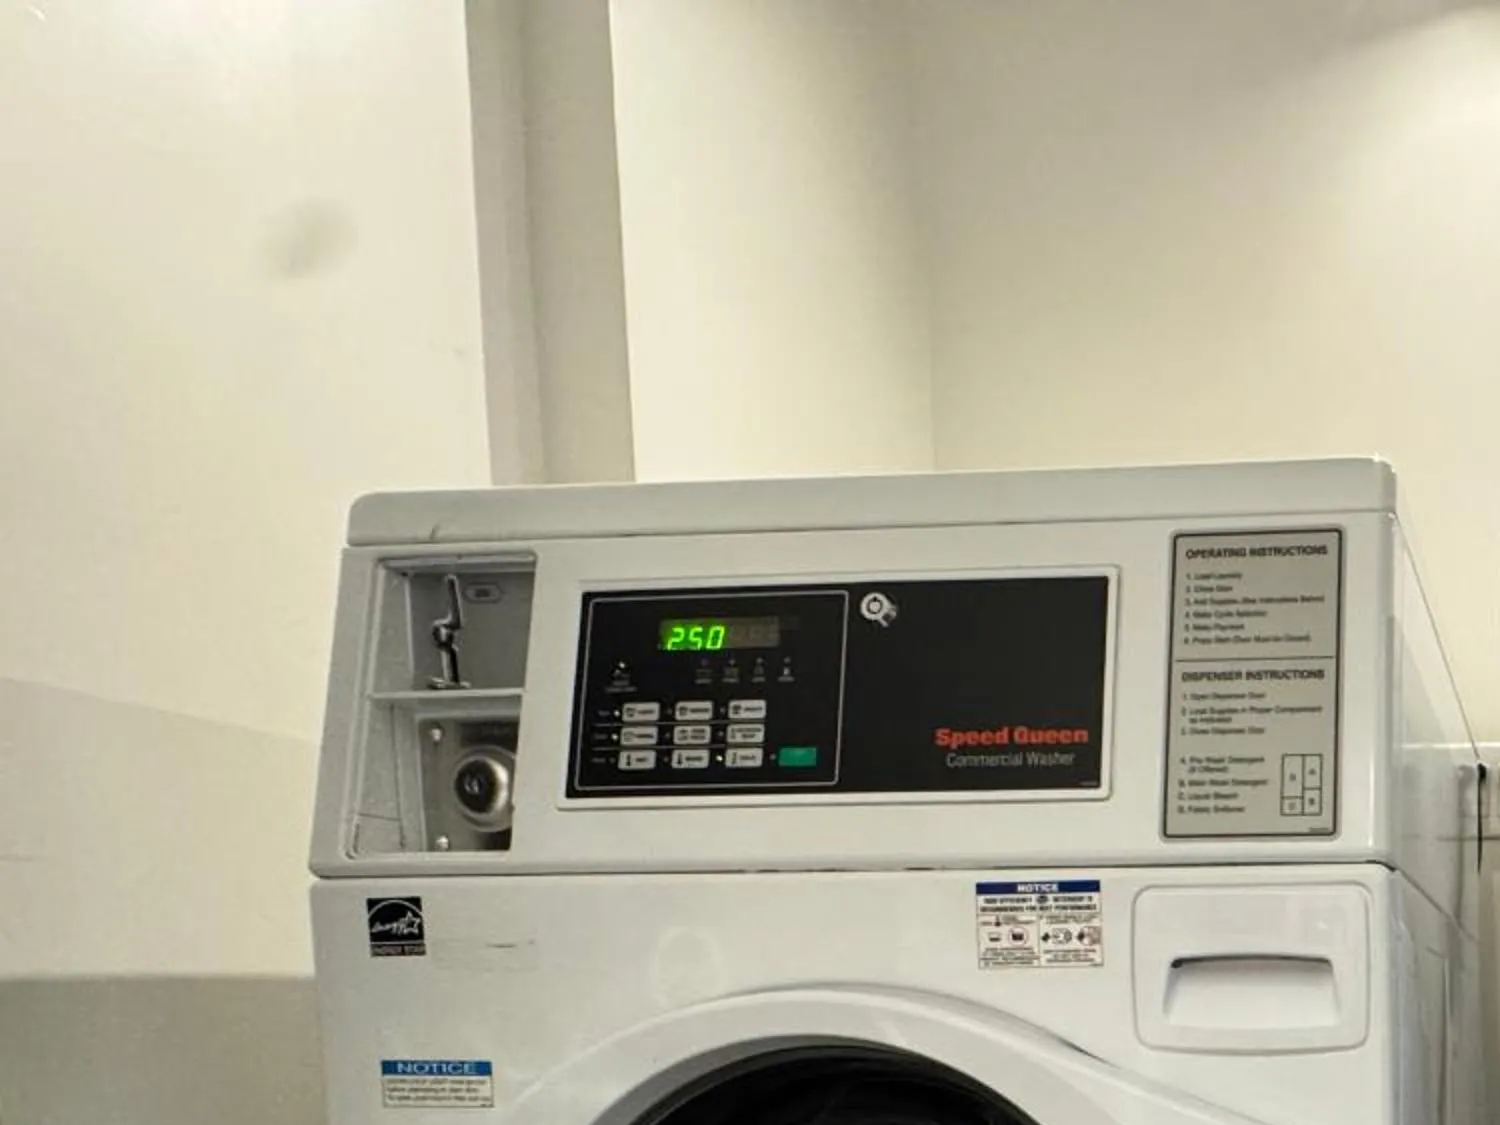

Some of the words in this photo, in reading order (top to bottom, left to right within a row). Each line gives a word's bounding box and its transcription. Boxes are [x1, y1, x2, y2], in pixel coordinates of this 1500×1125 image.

[1185, 547, 1247, 560] OPERATING
[1249, 544, 1328, 557] INSTRUCTIONS
[1181, 671, 1243, 682] DISPENSER
[1245, 669, 1325, 681] INSTRUCTIONS
[935, 726, 1009, 749] Speed
[1013, 725, 1089, 744] Queen
[945, 751, 1023, 768] Commercial
[1025, 750, 1075, 767] Washer
[396, 1063, 474, 1075] NOTICE
